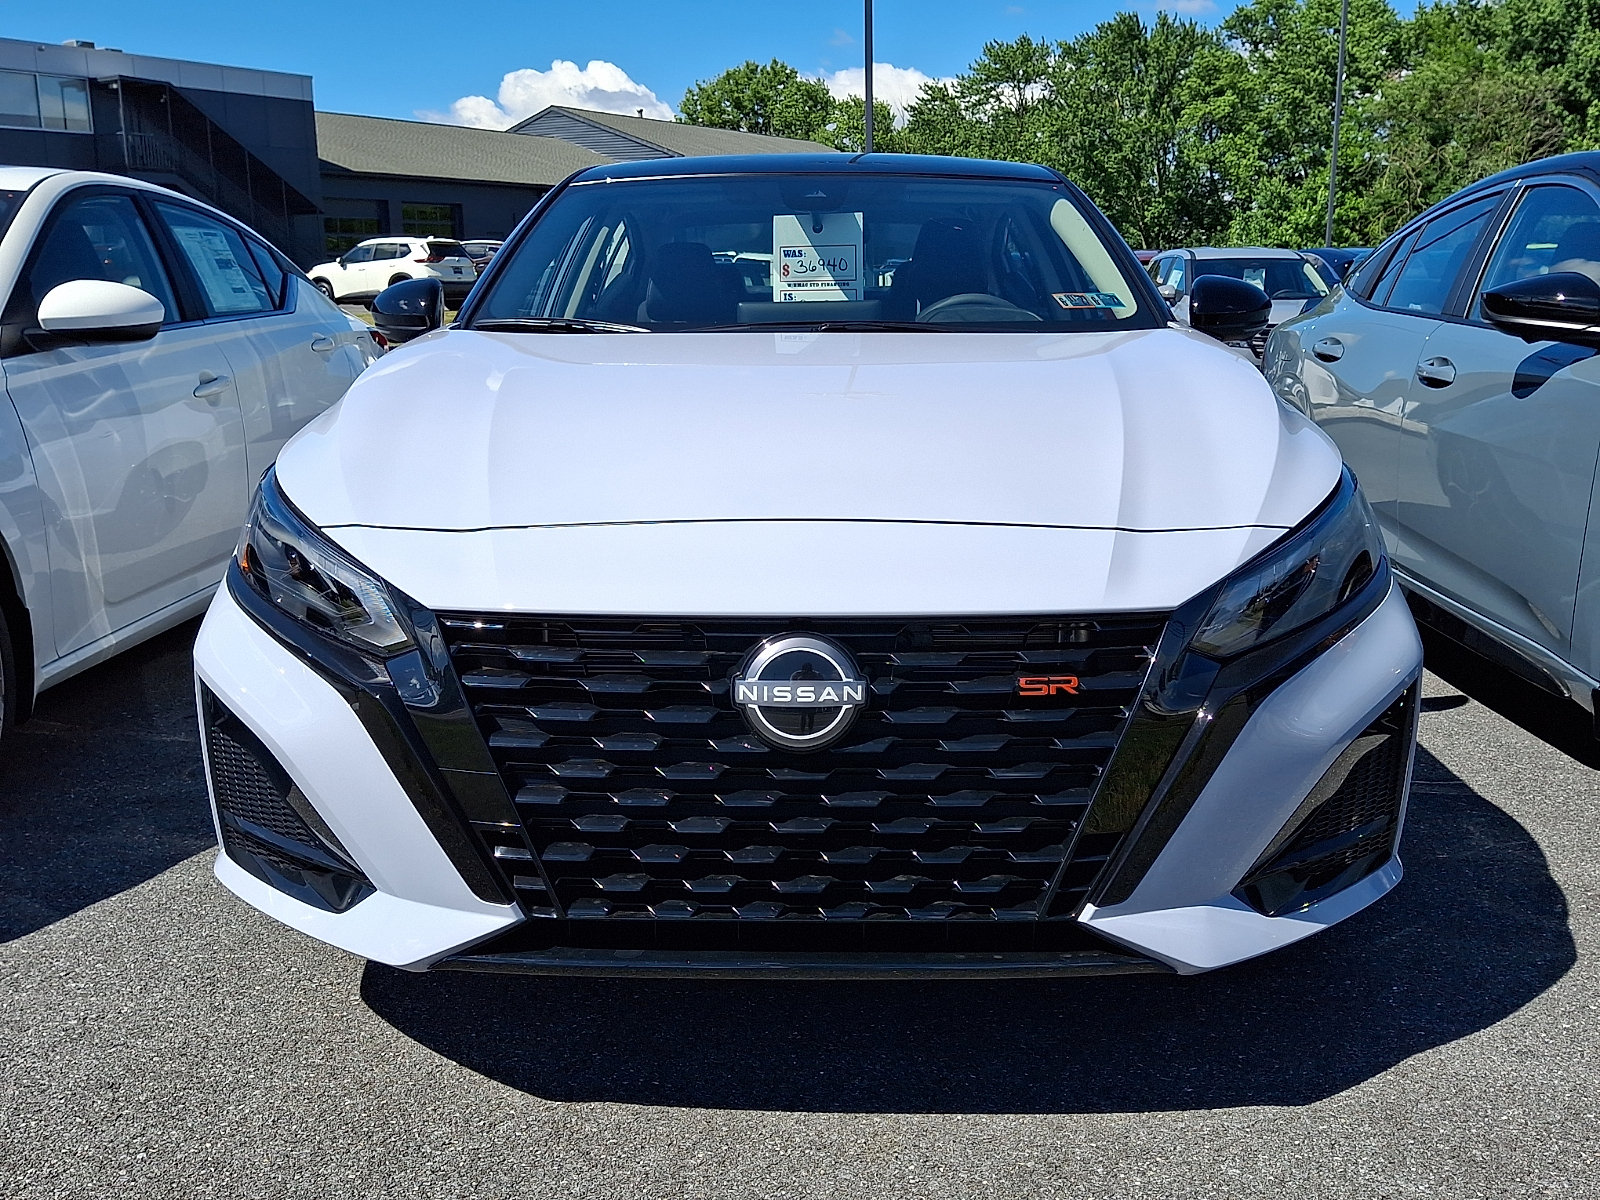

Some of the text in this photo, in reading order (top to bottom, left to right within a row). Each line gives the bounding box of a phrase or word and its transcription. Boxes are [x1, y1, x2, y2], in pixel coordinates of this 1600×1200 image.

[782, 257, 848, 277] $ 36940
[738, 684, 863, 702] NISSAN
[1018, 675, 1080, 696] SR
